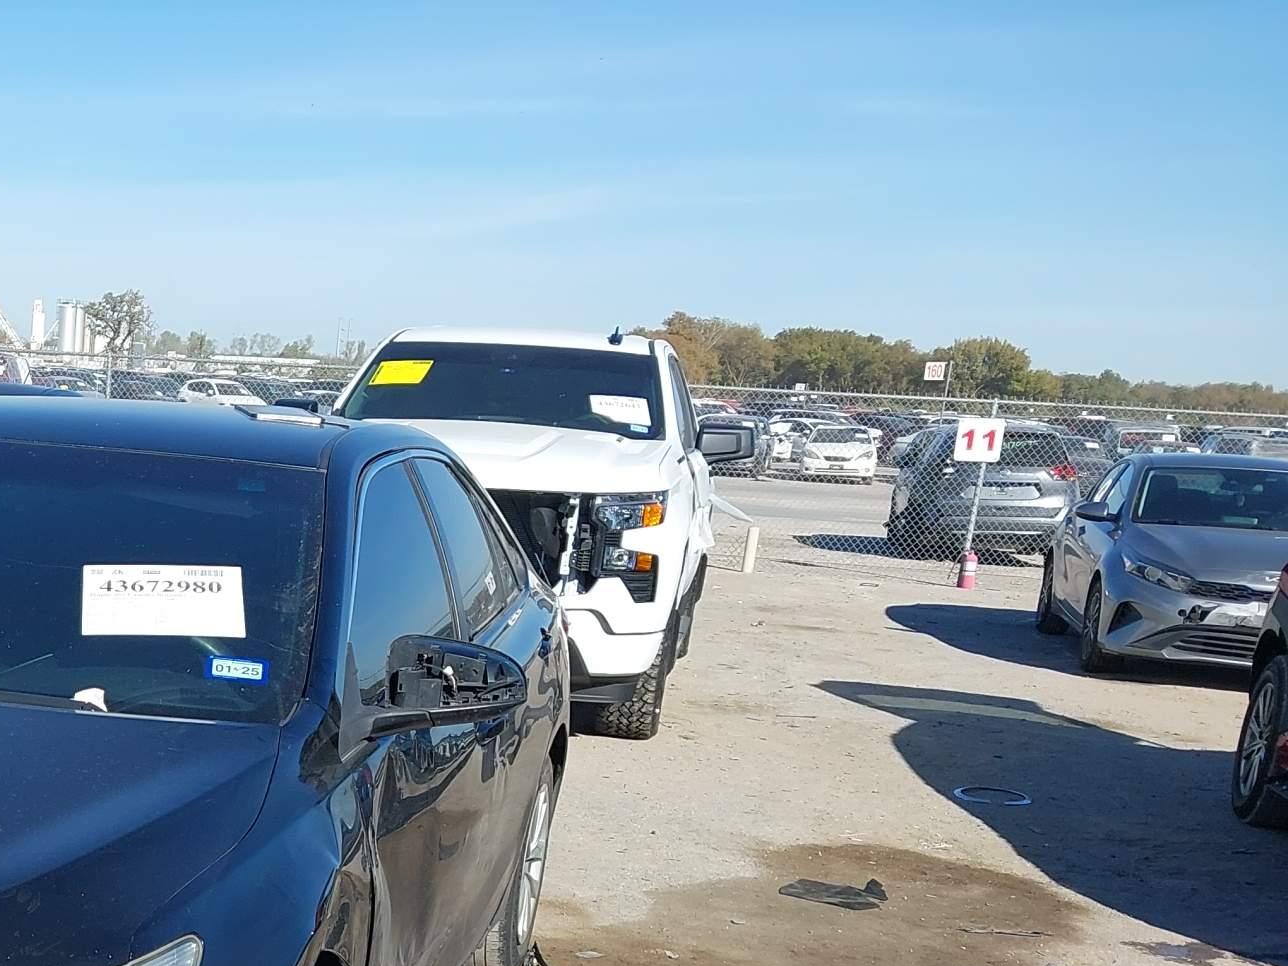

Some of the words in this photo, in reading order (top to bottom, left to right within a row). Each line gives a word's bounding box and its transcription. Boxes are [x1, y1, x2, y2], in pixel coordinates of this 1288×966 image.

[927, 364, 943, 378] 160
[961, 428, 997, 451] 11
[99, 579, 222, 593] 43672980
